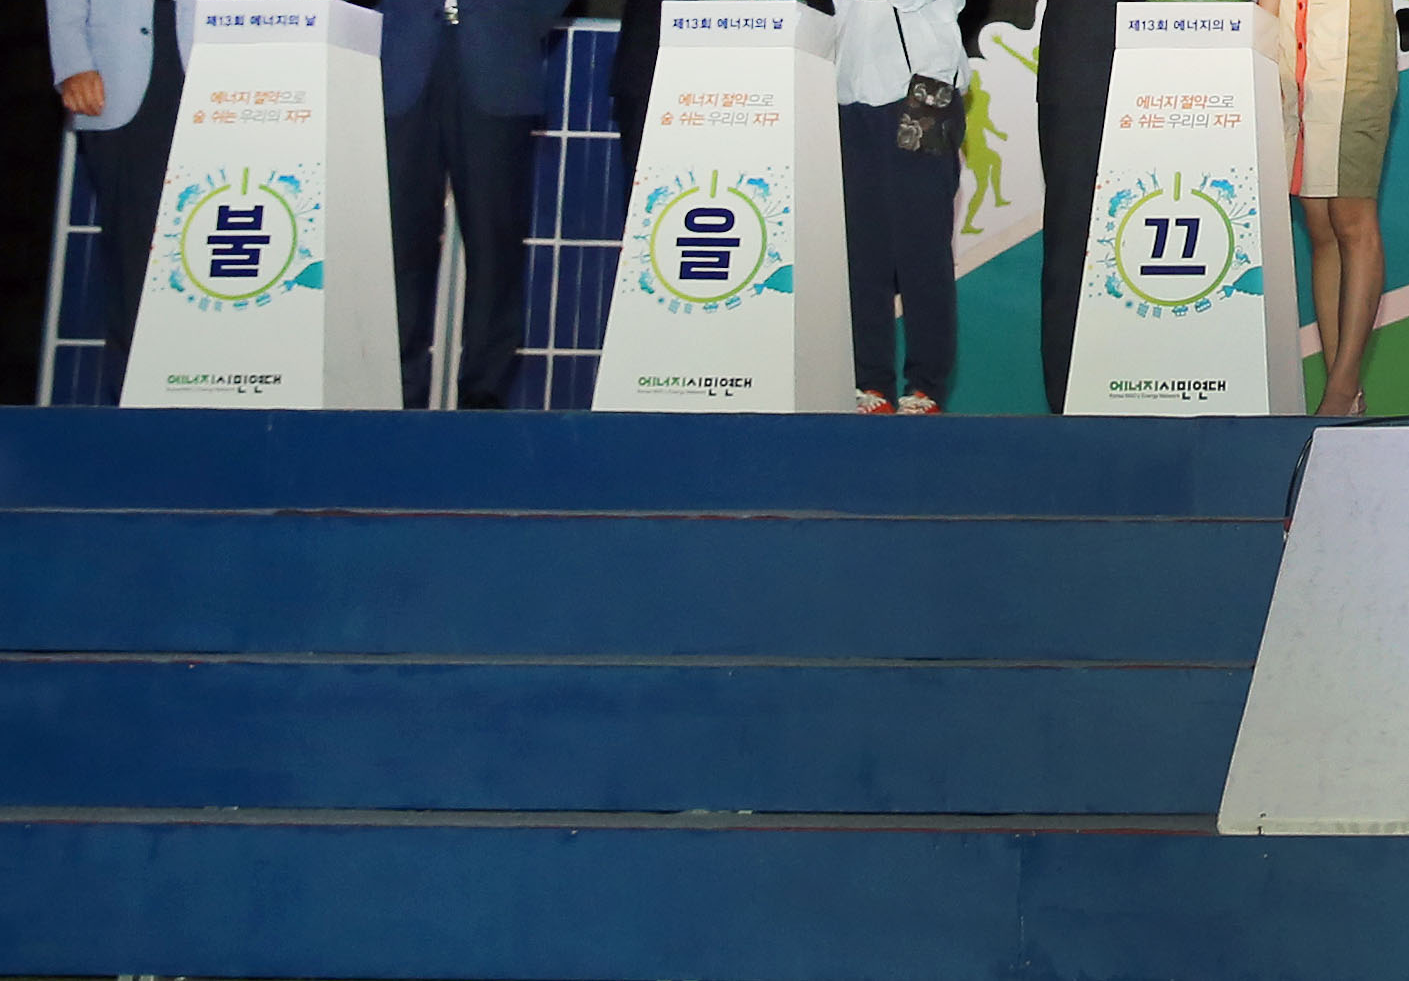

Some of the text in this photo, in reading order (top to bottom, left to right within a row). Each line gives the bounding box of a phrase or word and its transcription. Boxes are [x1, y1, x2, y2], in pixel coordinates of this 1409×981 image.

[673, 18, 784, 29] 제13회 에너지의 날
[1128, 19, 1242, 31] 제13회 에너지의 날
[678, 93, 774, 107] 에너지 절약으로
[1136, 95, 1234, 110] 에너지 절약으로
[680, 112, 705, 126] 쉬는
[707, 111, 749, 126] 우리의
[753, 112, 780, 126] 지구
[1120, 114, 1241, 129] 숨 쉬는 우리의 지구
[207, 205, 270, 277] 불
[676, 208, 740, 280] 을
[1140, 218, 1206, 275] 끄
[639, 377, 752, 396] 에너지시민연대
[1110, 381, 1226, 400] 에너지시민연대
